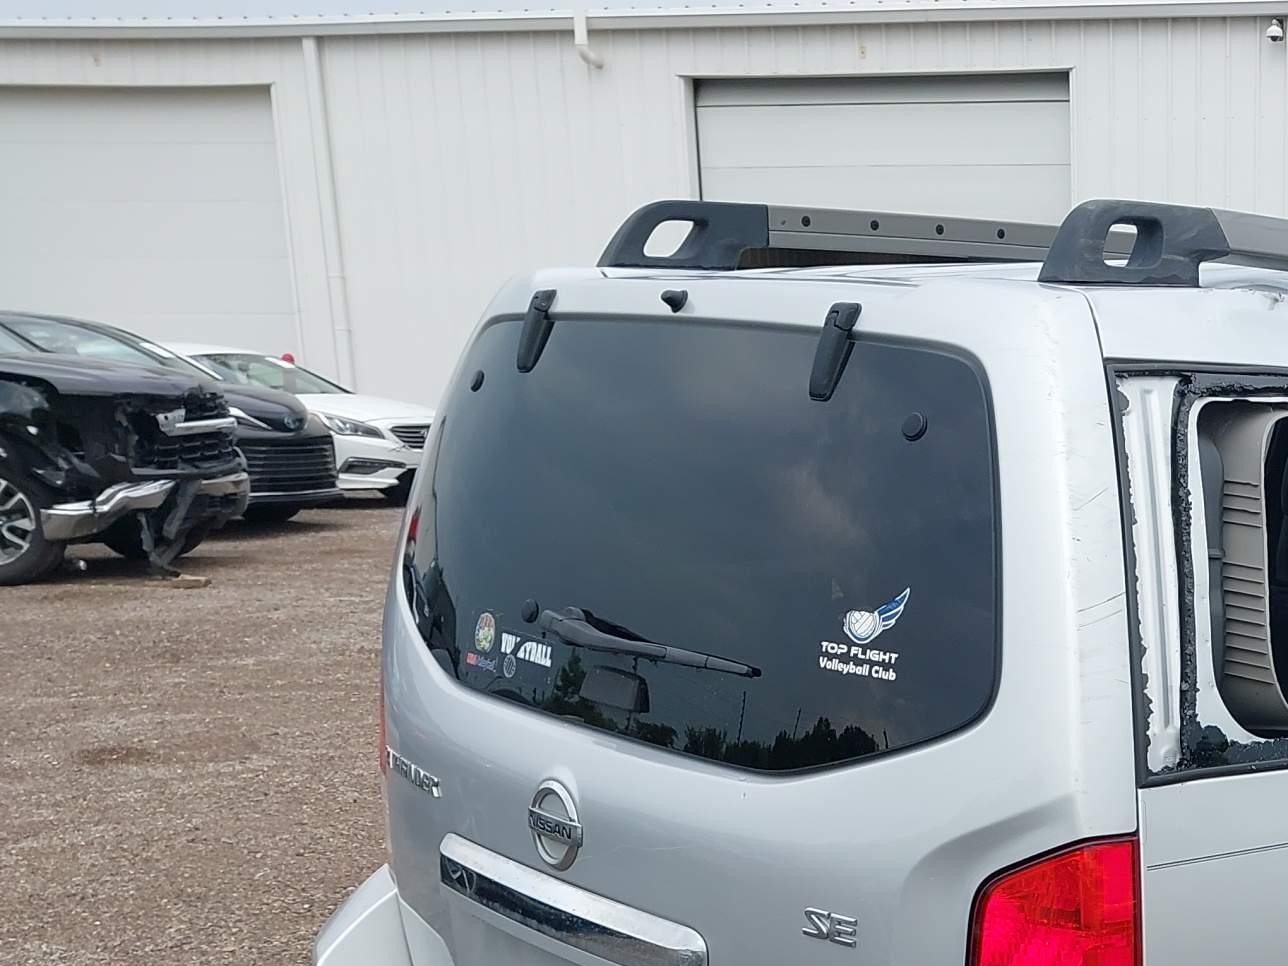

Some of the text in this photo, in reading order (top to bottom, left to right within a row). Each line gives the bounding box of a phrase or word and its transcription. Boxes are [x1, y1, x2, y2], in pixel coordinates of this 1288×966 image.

[820, 641, 899, 664] TOP FLIGHT
[819, 656, 897, 681] Volleyball Club
[529, 814, 573, 840] NISSAN
[802, 907, 858, 948] SE
